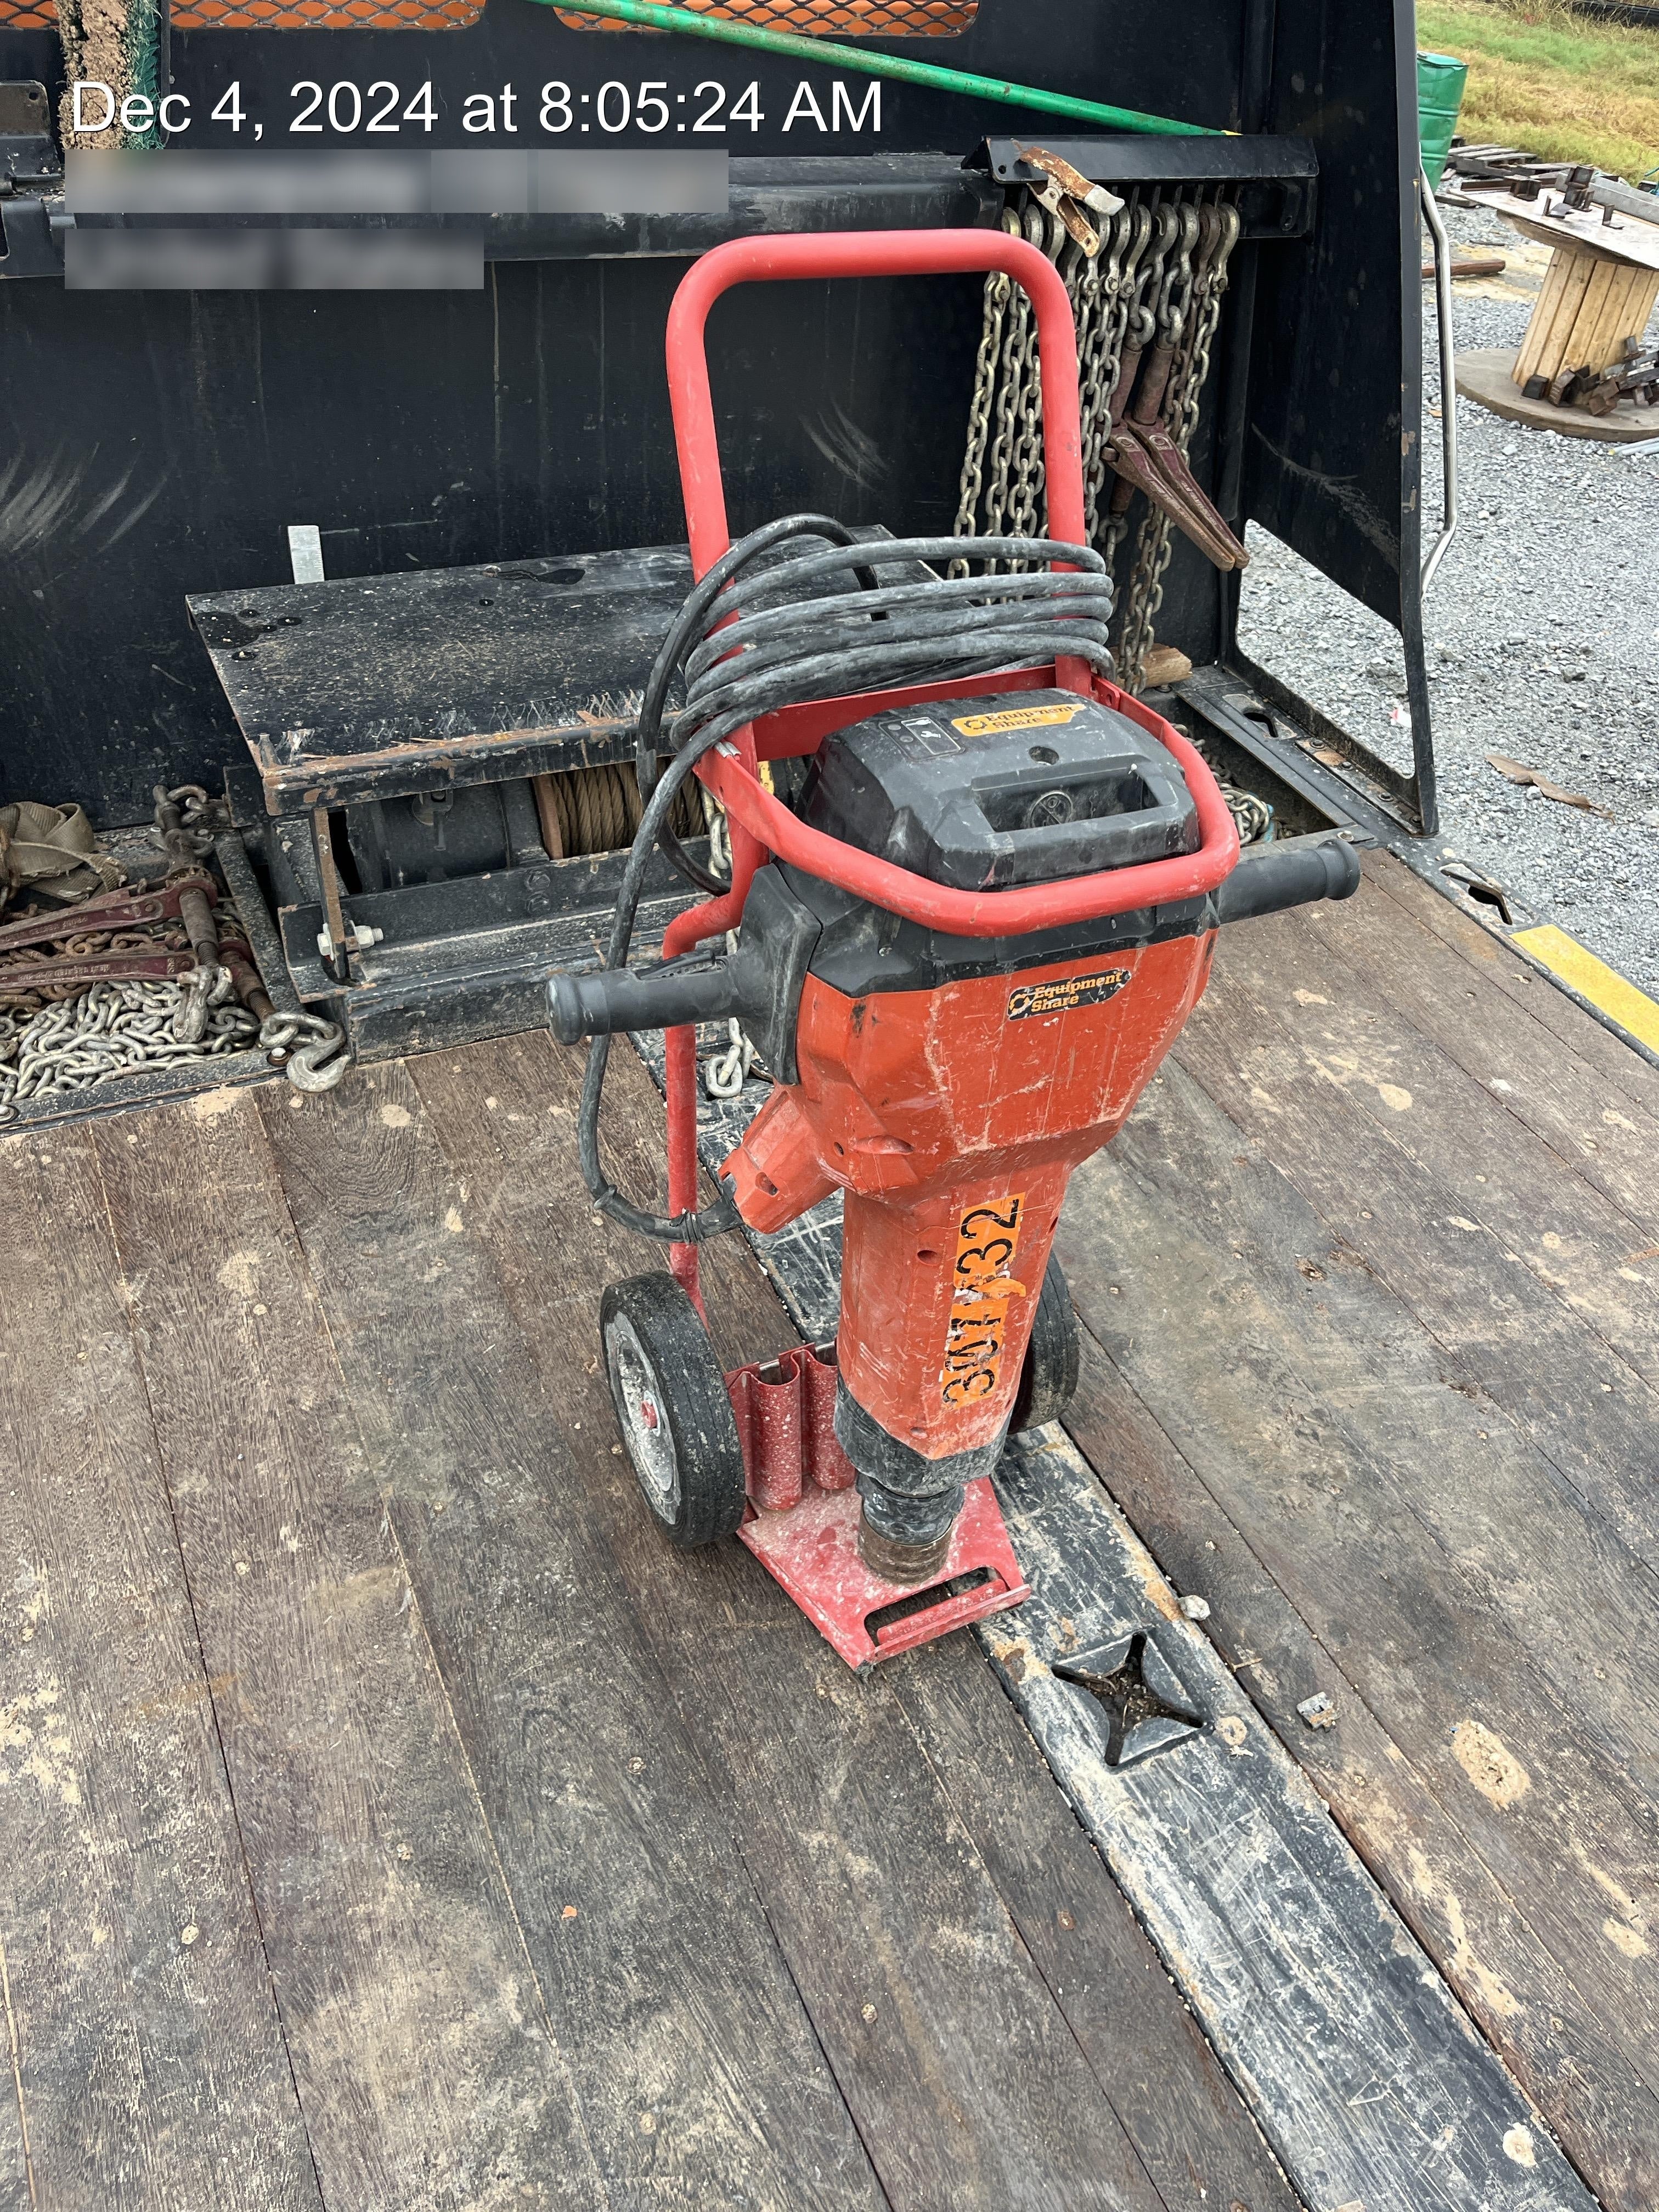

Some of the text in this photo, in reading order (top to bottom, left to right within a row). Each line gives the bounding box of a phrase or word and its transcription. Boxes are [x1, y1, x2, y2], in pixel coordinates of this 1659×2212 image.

[985, 705, 1074, 722] Equipment
[992, 716, 1042, 729] Share
[1034, 973, 1123, 998] Equipment
[1030, 994, 1080, 1013] Share
